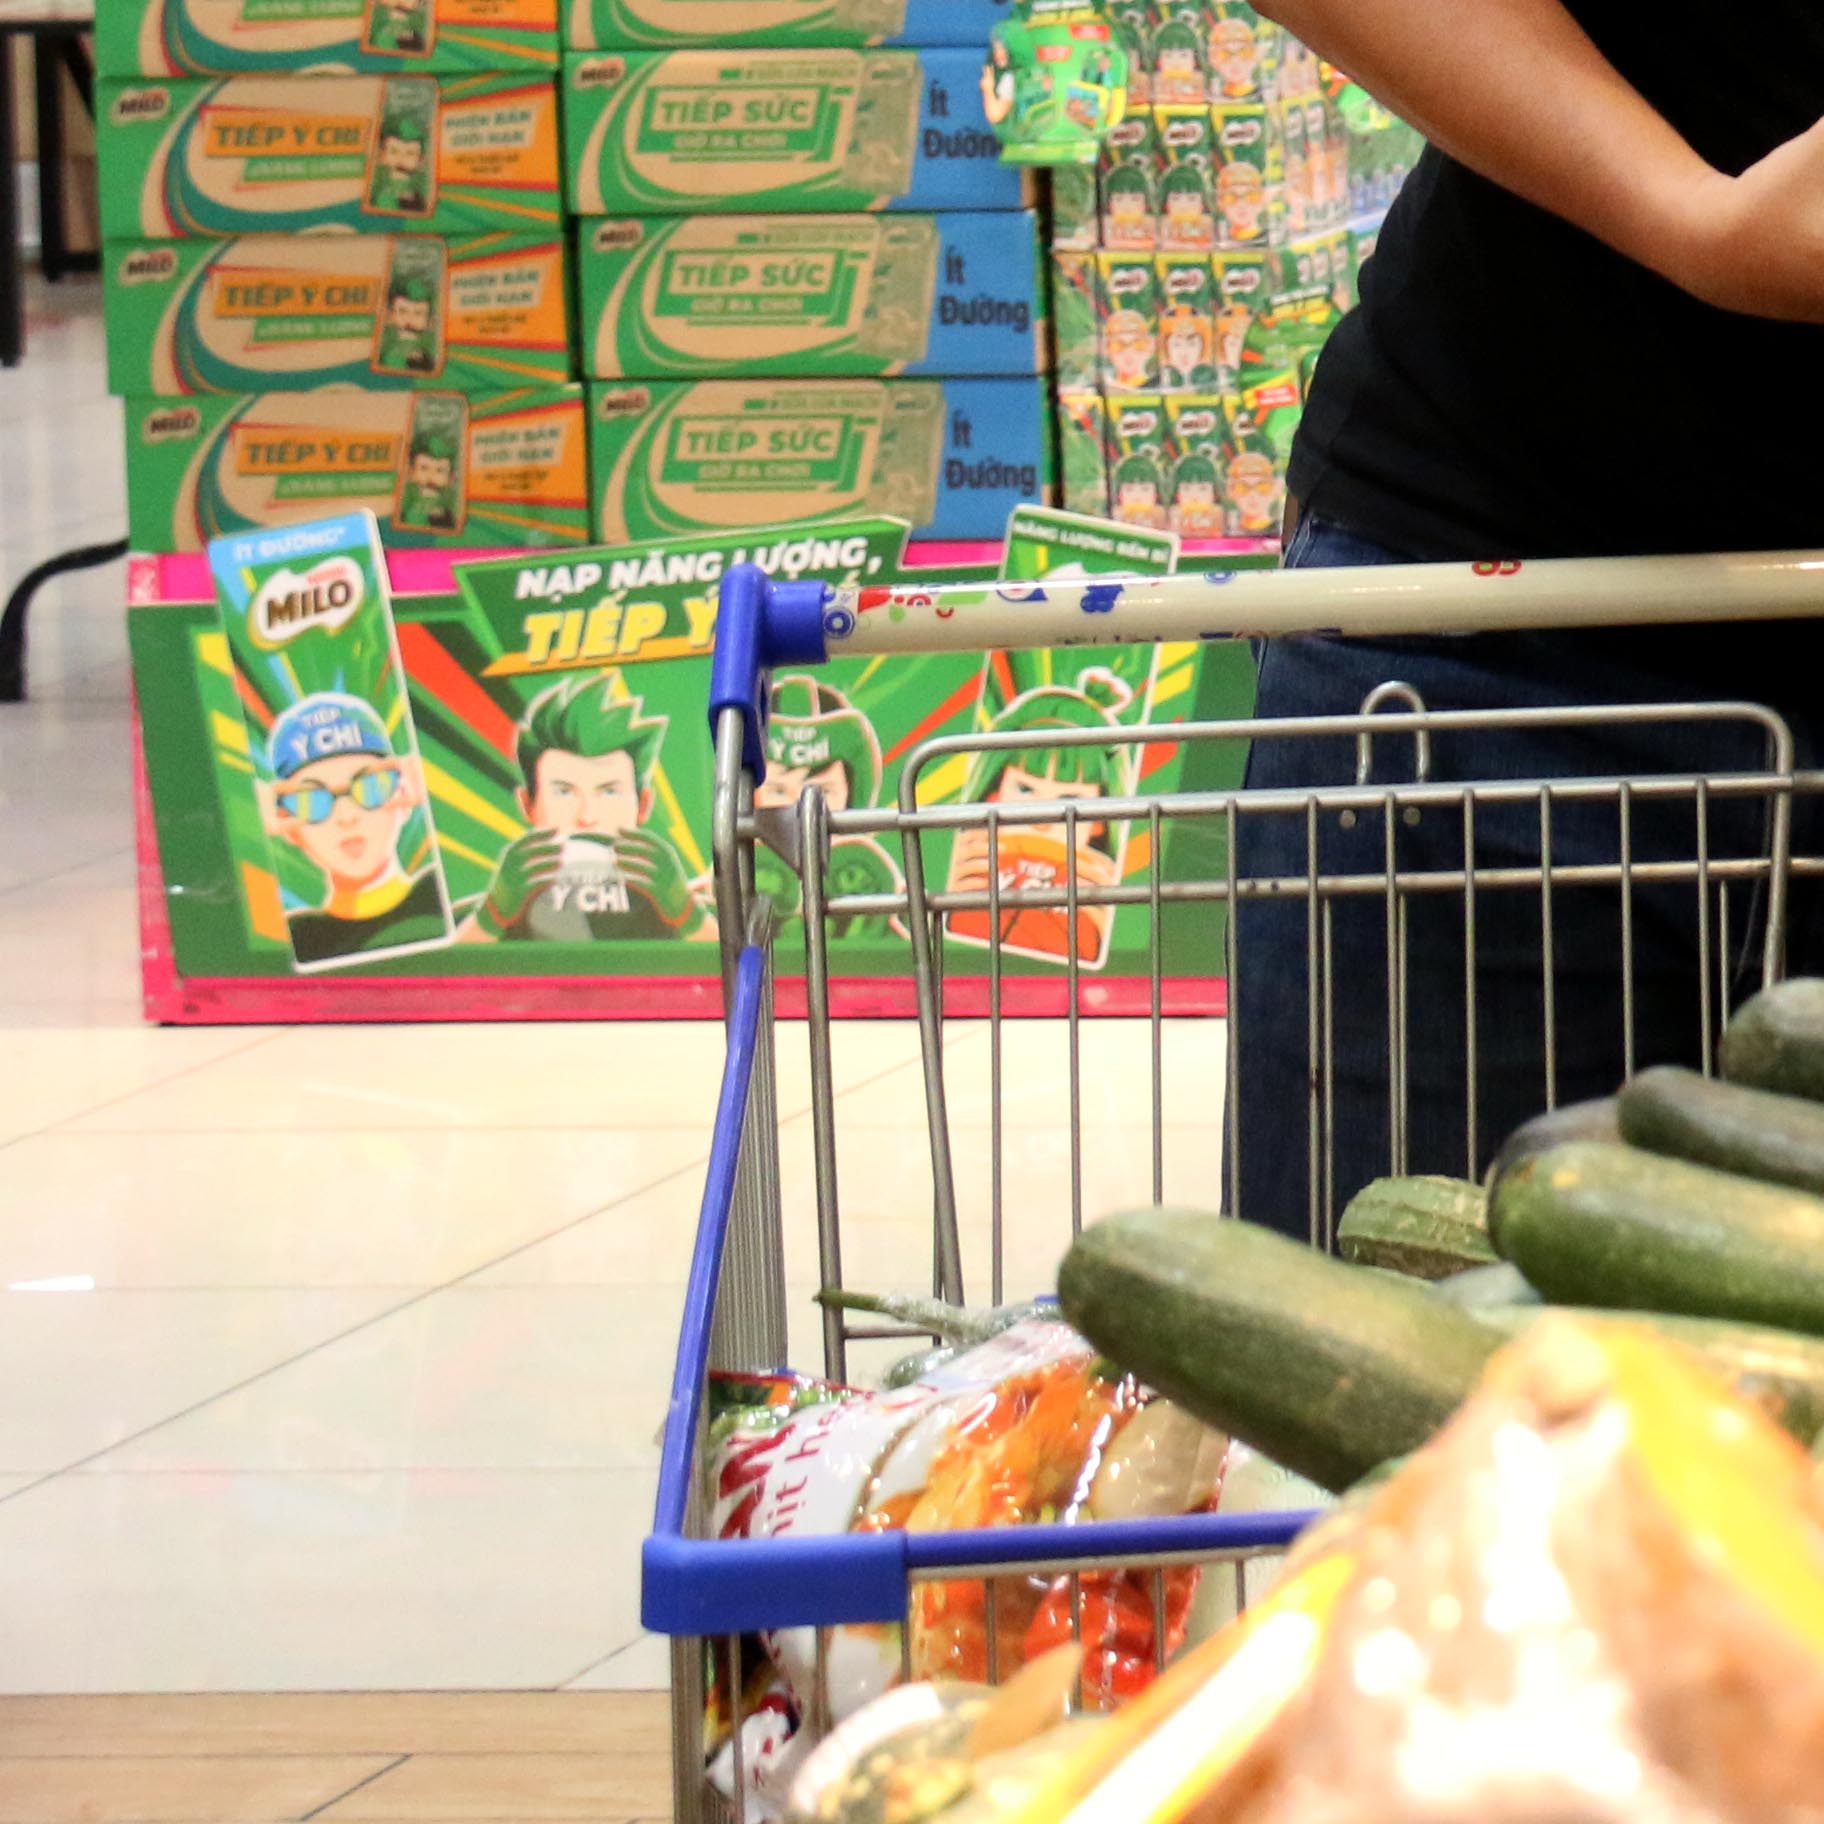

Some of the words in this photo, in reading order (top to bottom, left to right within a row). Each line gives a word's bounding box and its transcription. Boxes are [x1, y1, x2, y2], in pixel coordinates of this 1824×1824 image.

[660, 91, 737, 124] TIẾP
[744, 89, 810, 123] SỨC
[929, 80, 950, 119] Ít
[215, 119, 284, 148] TIẾP
[923, 124, 1000, 160] Đườn
[677, 257, 751, 290] TIẾP
[759, 256, 827, 289] SỨC
[944, 245, 965, 285] Ít
[223, 278, 292, 307] TIẾP
[939, 294, 1030, 332] Đường
[686, 421, 760, 454] TIẾP
[768, 419, 833, 453] SỨC
[951, 409, 971, 448] Ít
[246, 436, 314, 464] TIẾP
[946, 457, 1037, 494] Đường
[515, 562, 602, 604] NẠP
[608, 549, 723, 591] NĂNG
[733, 536, 883, 578] LƯỢNG,
[266, 579, 351, 629] MILO
[523, 589, 668, 665] TIẾP
[790, 734, 831, 764] CHÍ
[577, 879, 631, 913] CHÍ
